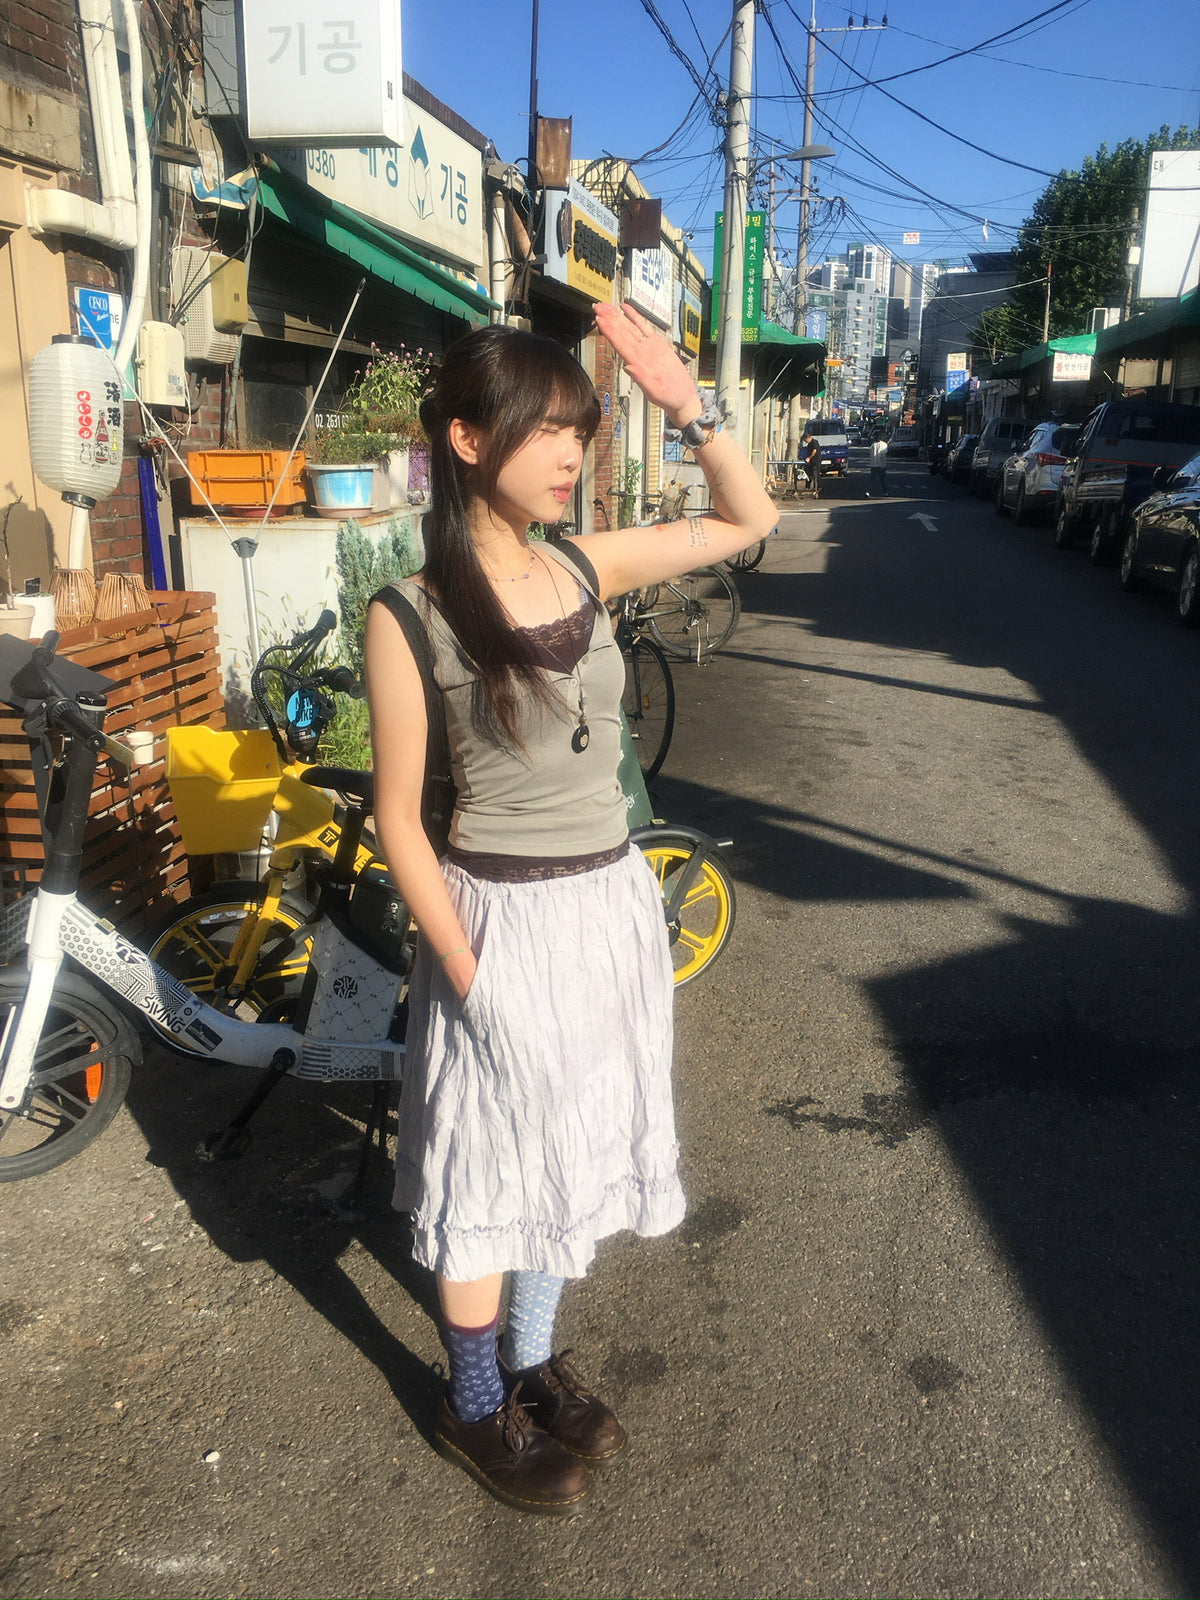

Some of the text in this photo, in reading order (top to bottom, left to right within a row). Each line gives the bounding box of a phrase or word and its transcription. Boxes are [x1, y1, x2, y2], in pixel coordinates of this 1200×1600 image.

[267, 20, 362, 76] 기공
[440, 163, 468, 226] 기공
[89, 296, 108, 311] CESCO
[315, 413, 323, 428] 02
[326, 414, 341, 429] 2631
[140, 996, 186, 1034] SWING
